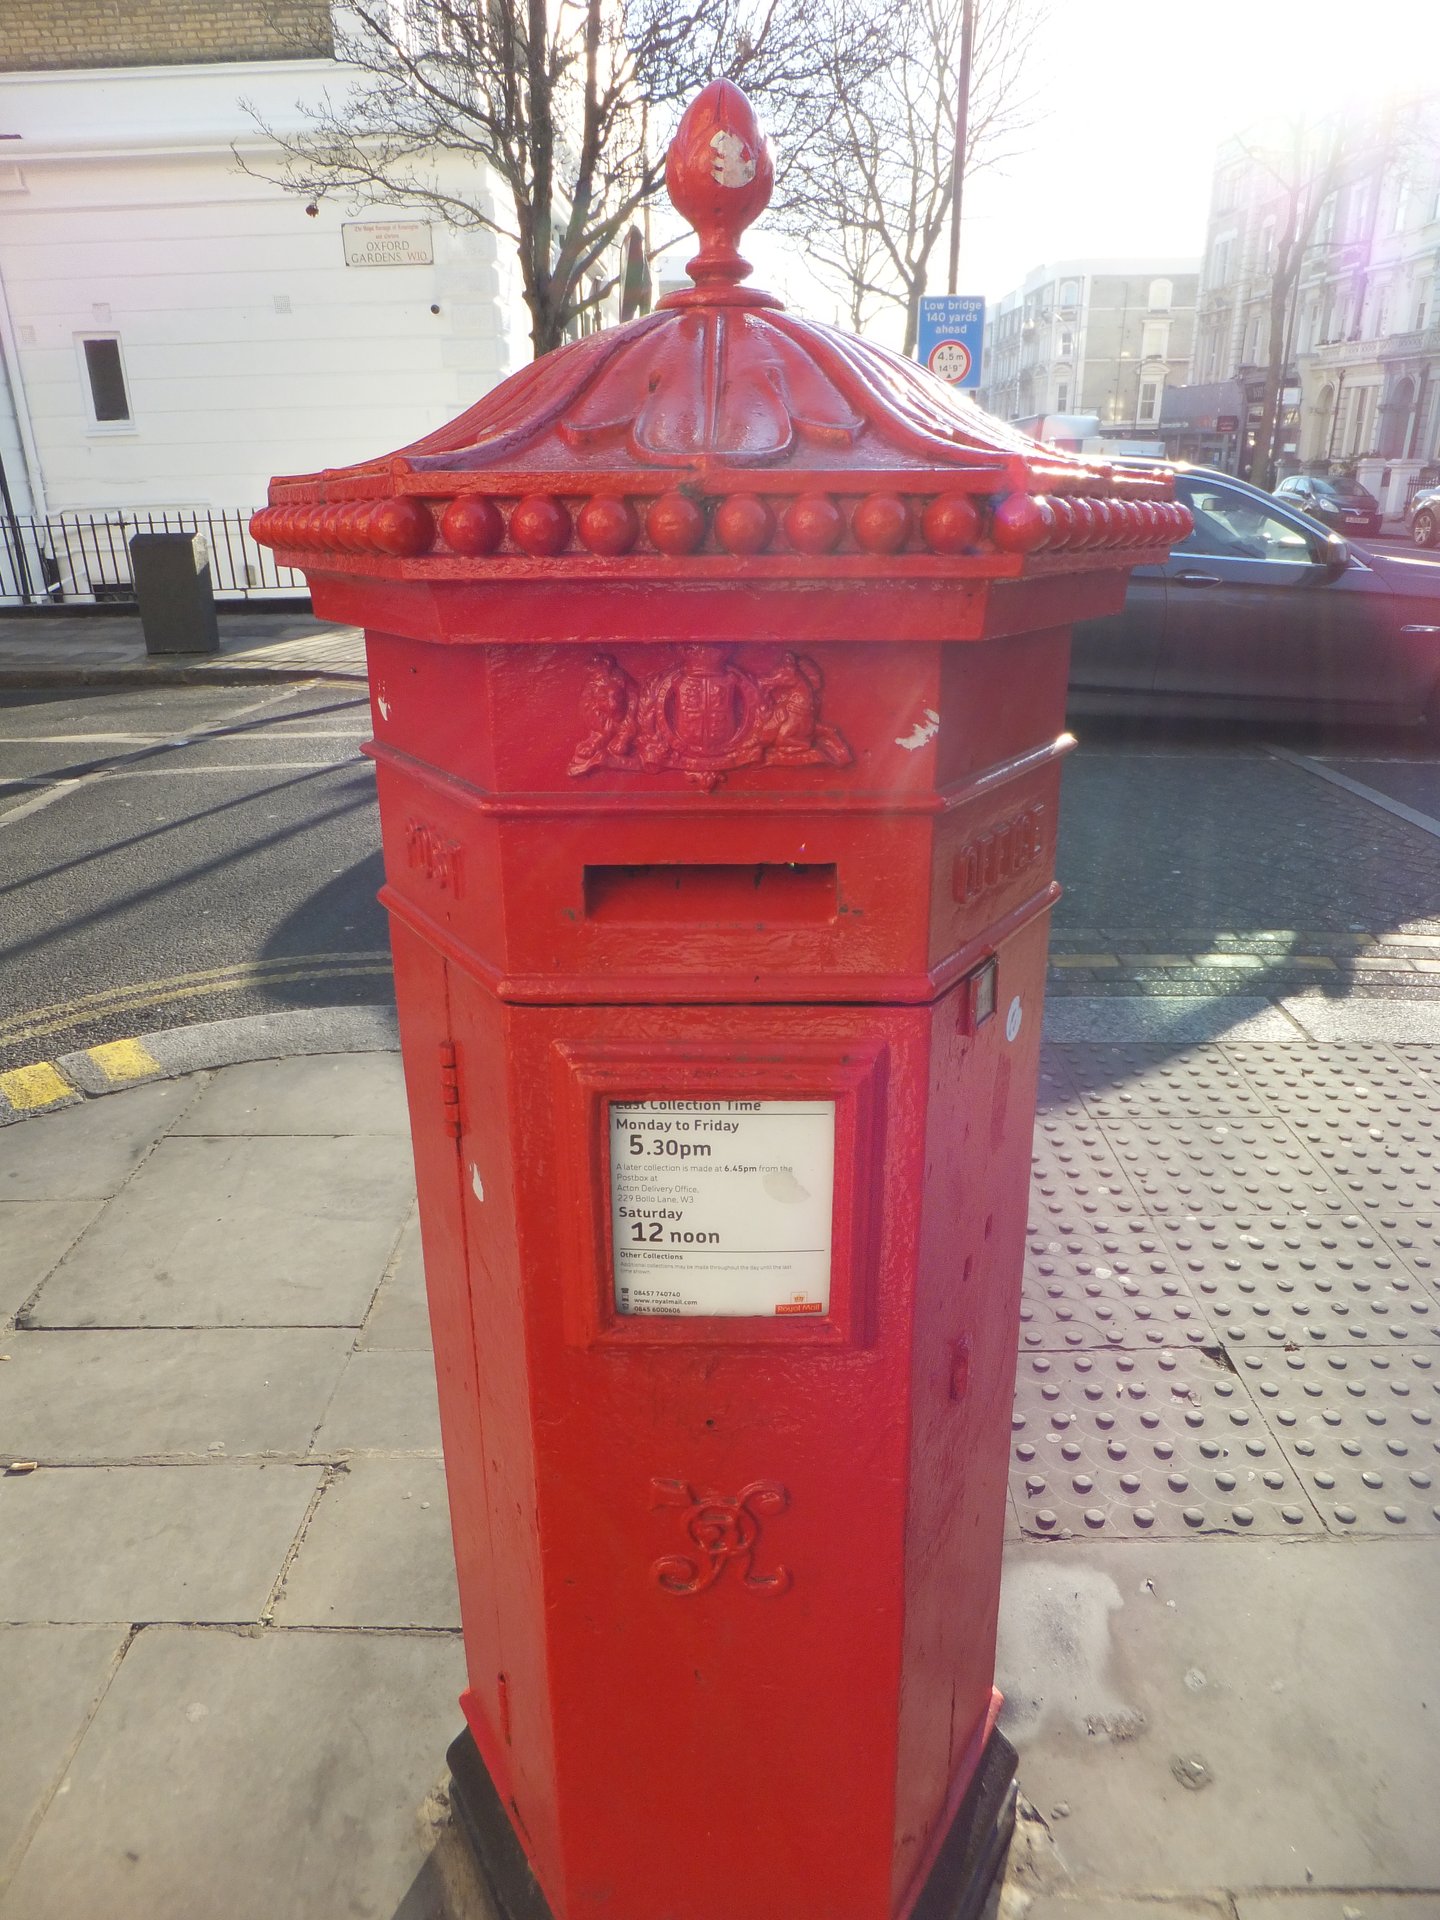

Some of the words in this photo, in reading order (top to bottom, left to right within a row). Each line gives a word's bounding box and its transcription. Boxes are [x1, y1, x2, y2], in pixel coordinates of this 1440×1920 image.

[366, 241, 409, 251] OXFORD
[924, 301, 944, 310] Low
[948, 301, 982, 311] bridge
[927, 312, 945, 322] 140
[949, 312, 977, 324] yards
[936, 325, 967, 334] ahead
[651, 1101, 721, 1111] Collection
[727, 1101, 761, 1111] Time
[616, 1118, 671, 1132] Monday
[676, 1120, 691, 1131] to
[694, 1120, 739, 1133] Friday
[629, 1134, 712, 1159] 5.30pm
[616, 1163, 622, 1171] A
[623, 1163, 642, 1171] later
[643, 1163, 681, 1172] collection
[683, 1164, 689, 1172] is
[690, 1164, 713, 1173] made
[714, 1165, 722, 1173] at
[724, 1165, 757, 1174] 6.45pm
[758, 1164, 778, 1173] from
[780, 1165, 793, 1173] the
[616, 1174, 648, 1182] Postbox
[616, 1184, 640, 1192] Acton
[641, 1184, 673, 1194] Delivery
[617, 1194, 633, 1202] 229
[680, 1196, 694, 1204] W3
[619, 1206, 683, 1221] Saturday
[631, 1221, 664, 1243] 12
[670, 1231, 720, 1244] noon
[620, 1251, 641, 1259] Other
[642, 1252, 683, 1260] Collections
[634, 1298, 698, 1306] www.royalmail.com
[634, 1305, 651, 1313] 0845
[652, 1306, 681, 1314] 6000606
[777, 1304, 801, 1313] Royal
[802, 1303, 820, 1312] Mail
